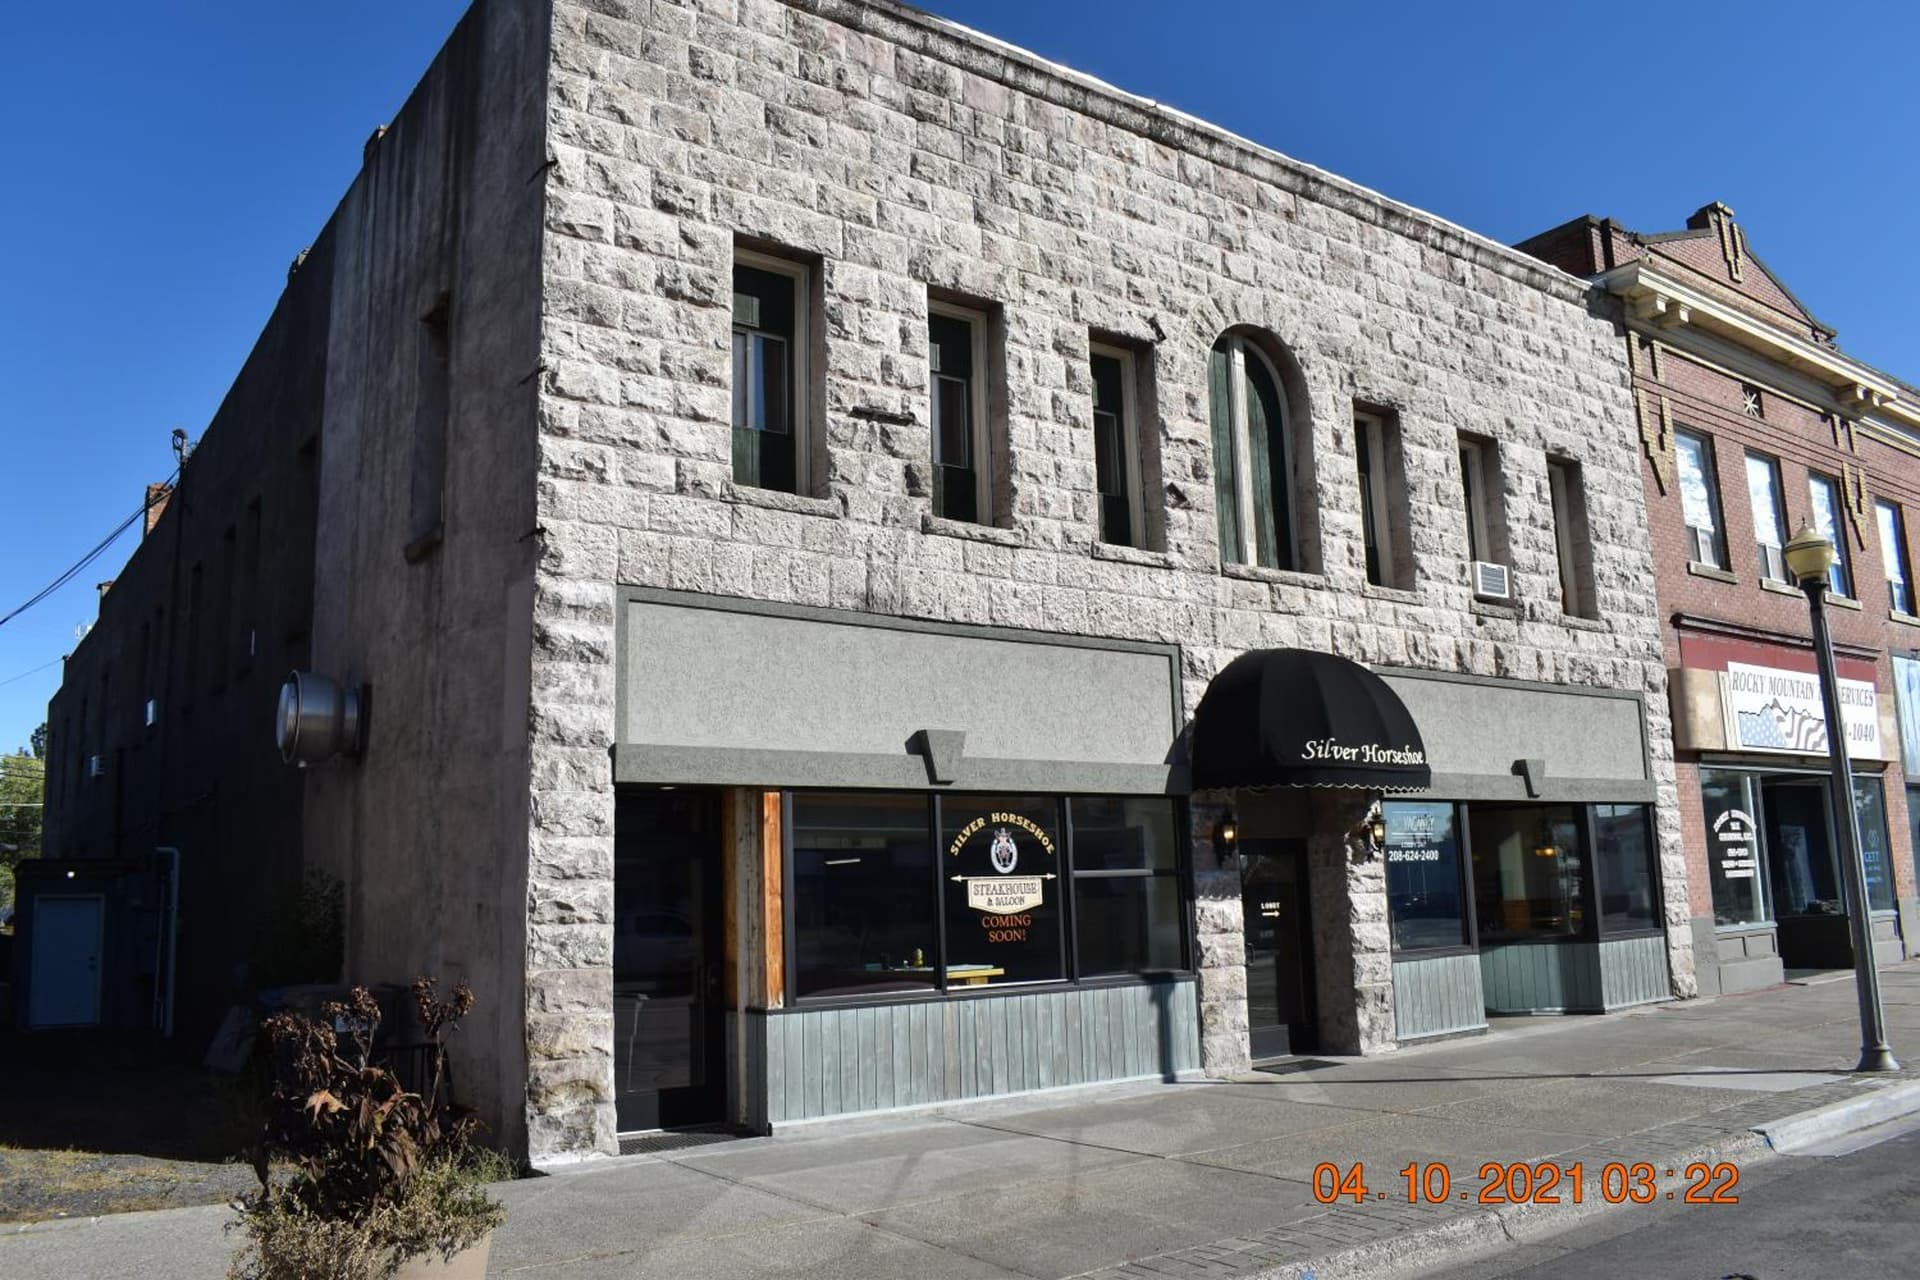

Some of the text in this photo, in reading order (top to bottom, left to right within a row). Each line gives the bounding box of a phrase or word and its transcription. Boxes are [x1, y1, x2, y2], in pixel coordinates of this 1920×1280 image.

[1732, 671, 1766, 696] ROCKY
[1768, 676, 1815, 700] MOUNTAIN
[1838, 686, 1875, 707] ERVICES
[1301, 737, 1425, 765] Silver Horseshoe
[950, 811, 1055, 856] SILVER HORSESHOE
[973, 881, 1037, 896] STEAKHOUSE
[995, 895, 1026, 906] SALOON
[981, 914, 1032, 928] COMING
[988, 929, 1027, 943] SOON!
